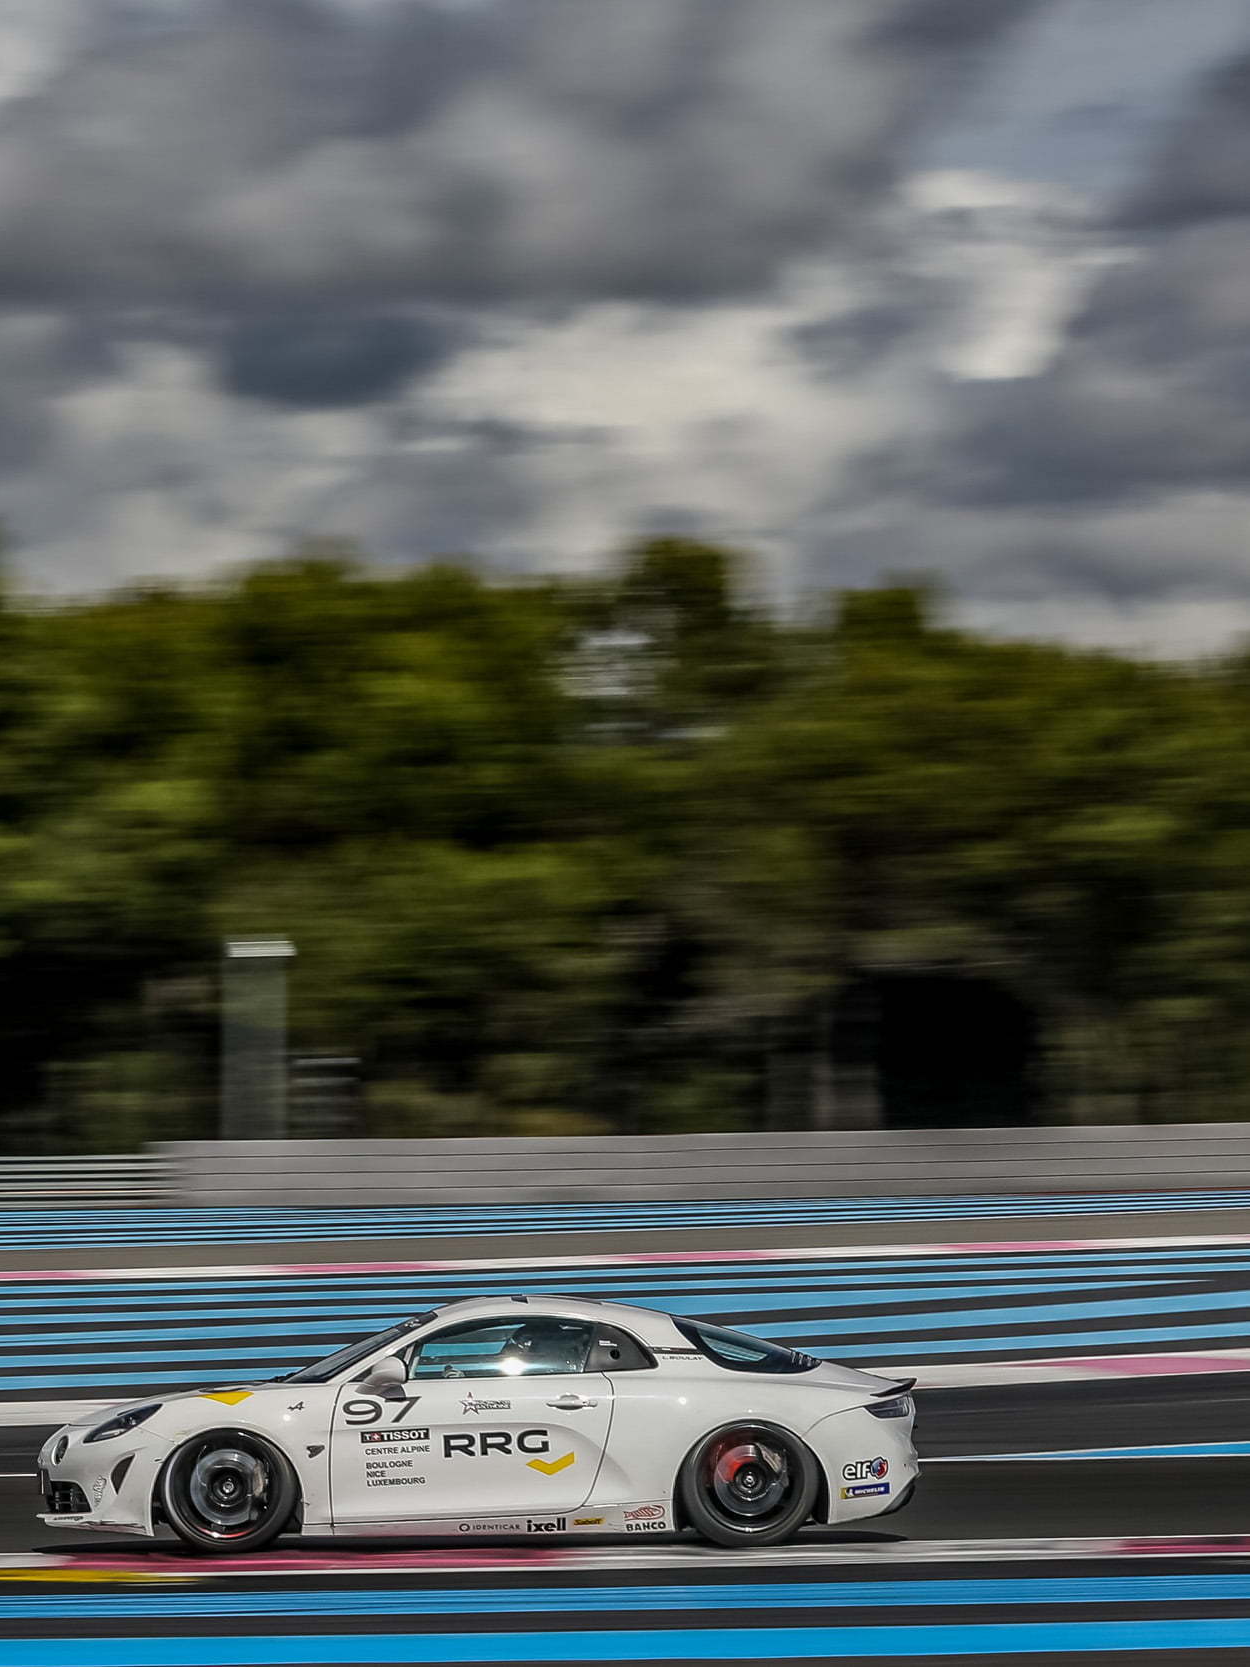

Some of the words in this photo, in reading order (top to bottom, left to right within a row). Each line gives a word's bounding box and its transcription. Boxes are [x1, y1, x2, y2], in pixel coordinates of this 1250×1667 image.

[342, 1395, 422, 1425] 97
[382, 1430, 428, 1441] TISSOT
[443, 1429, 550, 1458] RRG
[365, 1446, 399, 1456] CENTRE
[400, 1444, 431, 1454] ALPINE
[365, 1459, 413, 1470] BOULOGNE
[842, 1460, 872, 1481] elf
[366, 1470, 387, 1479] NICE
[366, 1476, 426, 1488] LUXEMBOURG
[472, 1522, 521, 1531] IDENTICAR
[526, 1516, 567, 1533] ixell
[625, 1520, 667, 1532] BANCO
